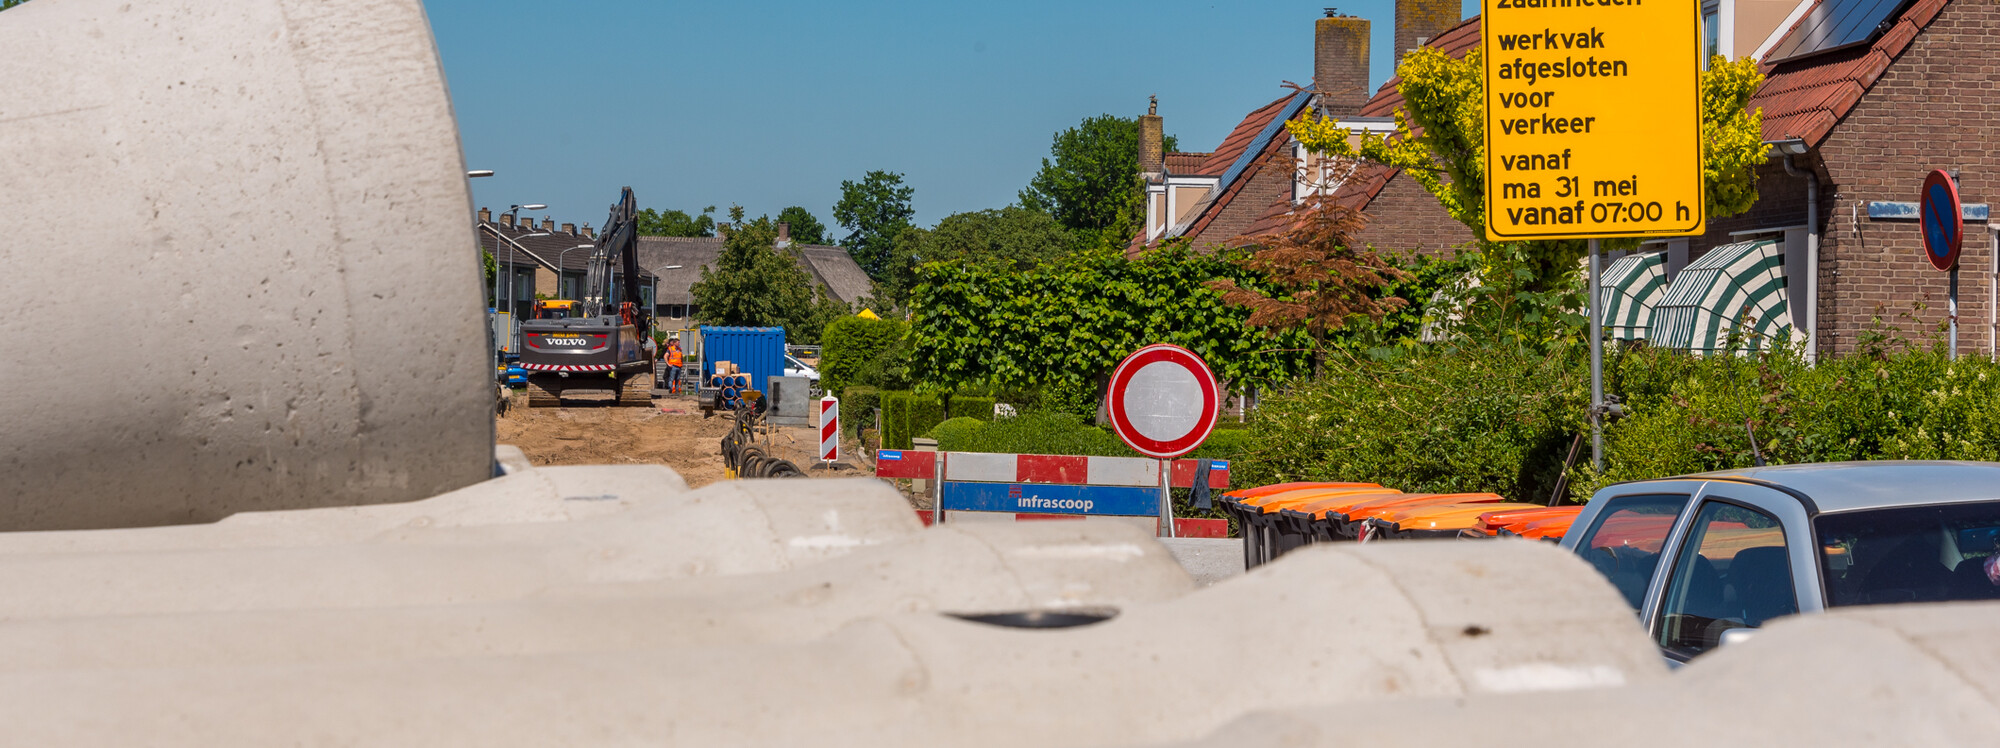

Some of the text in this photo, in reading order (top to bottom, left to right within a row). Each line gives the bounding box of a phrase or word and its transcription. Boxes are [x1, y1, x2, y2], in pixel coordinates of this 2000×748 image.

[1498, 27, 1605, 51] werkvak
[1498, 56, 1628, 86] afgesloten
[1499, 91, 1555, 109] voor
[1499, 113, 1596, 136] verkeer
[1500, 149, 1571, 171] vanaf
[1503, 175, 1637, 199] ma 31 mei
[1507, 201, 1690, 226] vanaf 07:00 h
[545, 338, 587, 346] VOLVO
[1018, 495, 1094, 512] infrascoop
